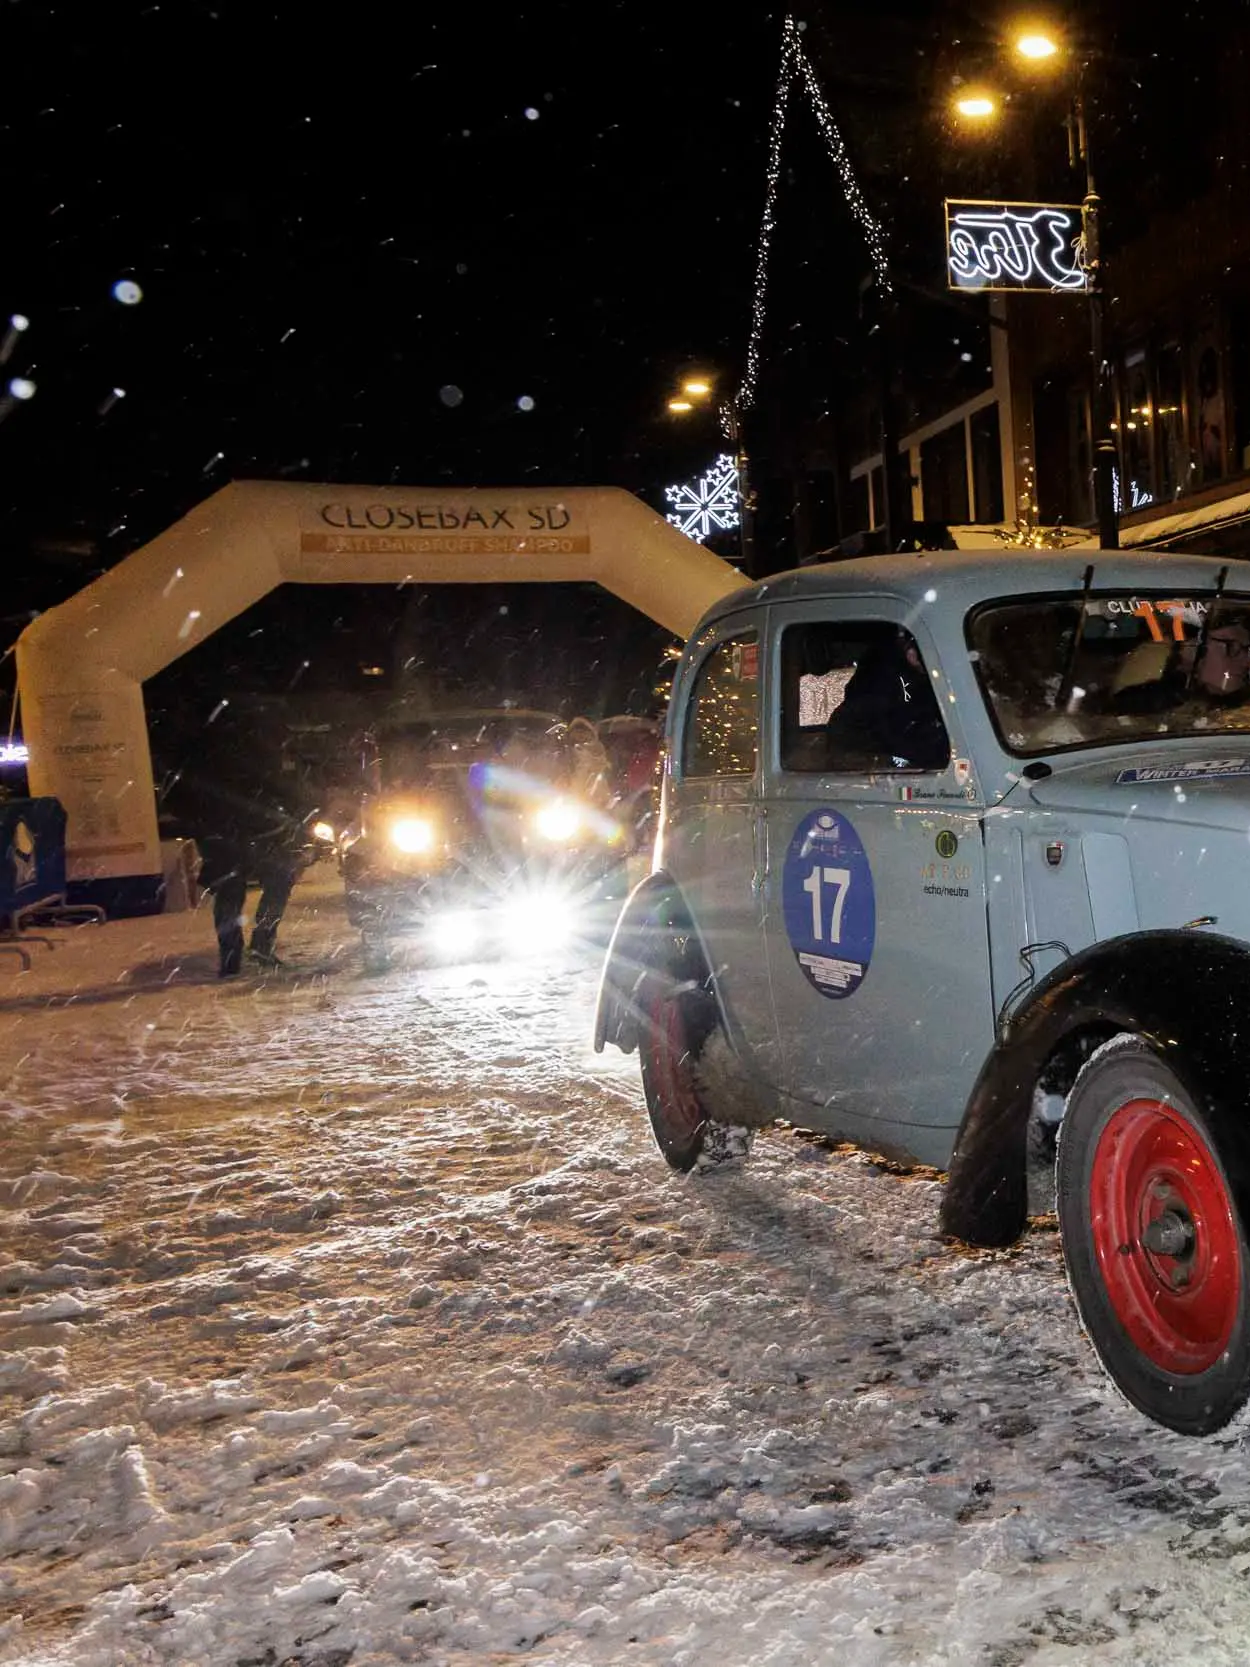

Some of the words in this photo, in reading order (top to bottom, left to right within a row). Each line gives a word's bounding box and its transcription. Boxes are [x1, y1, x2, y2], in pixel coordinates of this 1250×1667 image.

[320, 504, 515, 530] CLOSEBAX
[527, 504, 571, 531] SD
[1136, 768, 1198, 781] WINTER
[803, 865, 851, 944] 17
